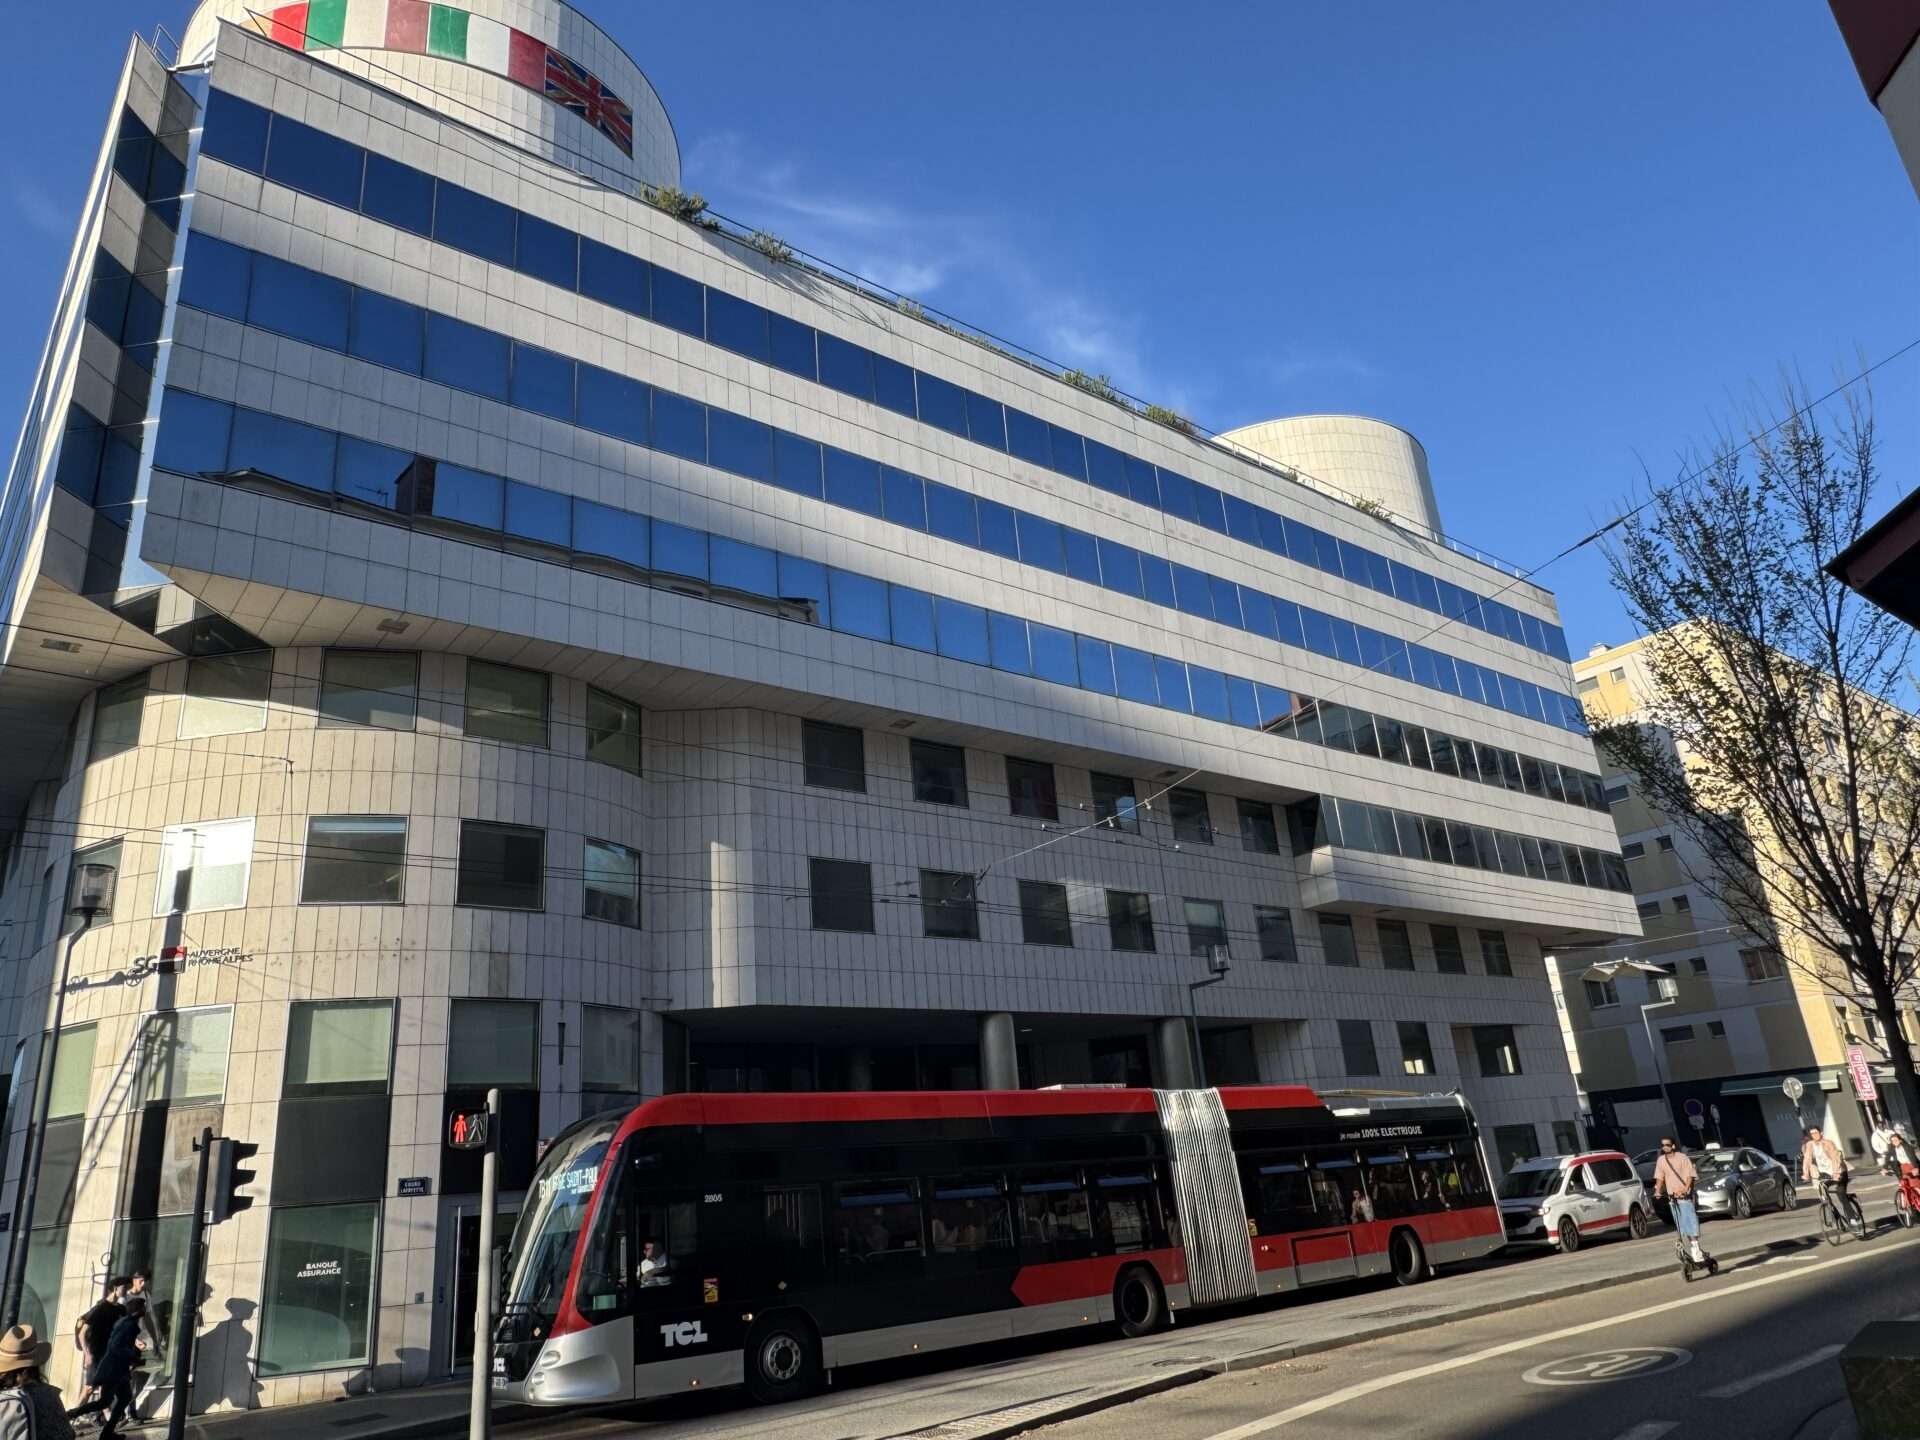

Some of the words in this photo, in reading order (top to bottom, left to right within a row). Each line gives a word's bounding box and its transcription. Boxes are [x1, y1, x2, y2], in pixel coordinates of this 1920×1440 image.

[188, 947, 241, 958] AUVERGNE
[1361, 1128, 1380, 1139] 100%
[306, 1260, 338, 1270] BANQUE
[297, 1267, 341, 1278] ASSURANCE
[660, 1320, 708, 1347] TCL
